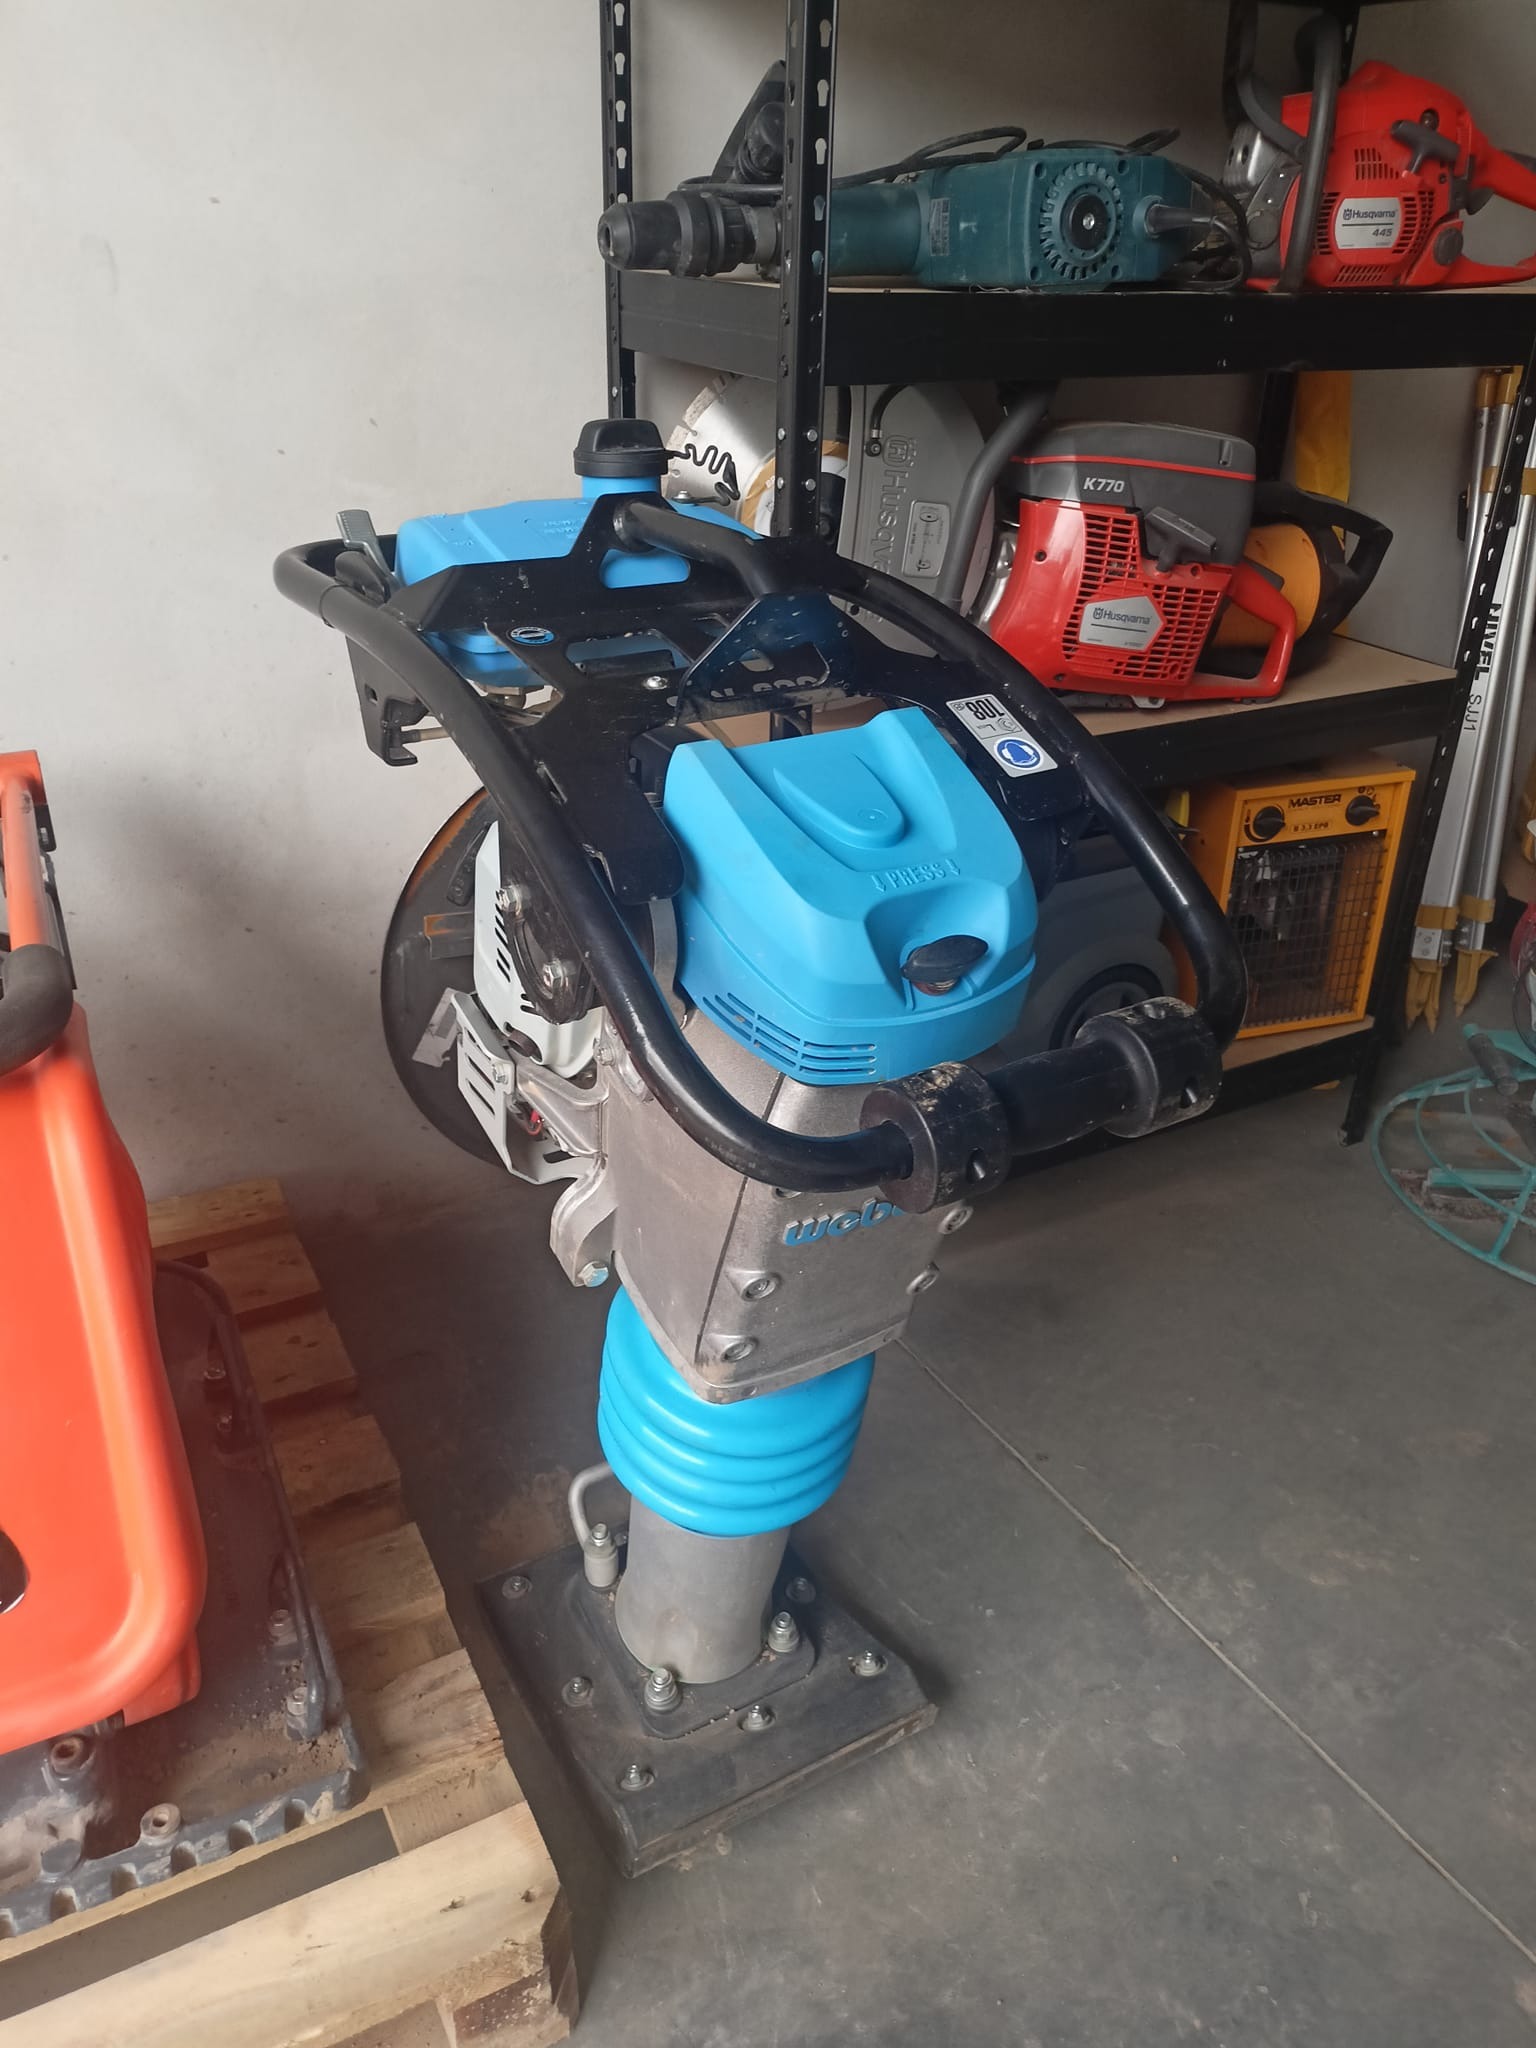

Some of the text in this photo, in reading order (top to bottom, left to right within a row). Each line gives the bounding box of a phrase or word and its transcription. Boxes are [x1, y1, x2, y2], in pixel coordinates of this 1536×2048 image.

[1352, 209, 1397, 219] Husqvarna
[1372, 228, 1393, 237] 445
[1083, 477, 1125, 493] K770
[1103, 609, 1151, 625] Husqvarna
[965, 698, 1005, 721] 108
[1463, 693, 1482, 732] SJJ1
[1289, 793, 1342, 808] MASTER
[885, 862, 947, 889] PRESS
[783, 1197, 906, 1246] web
